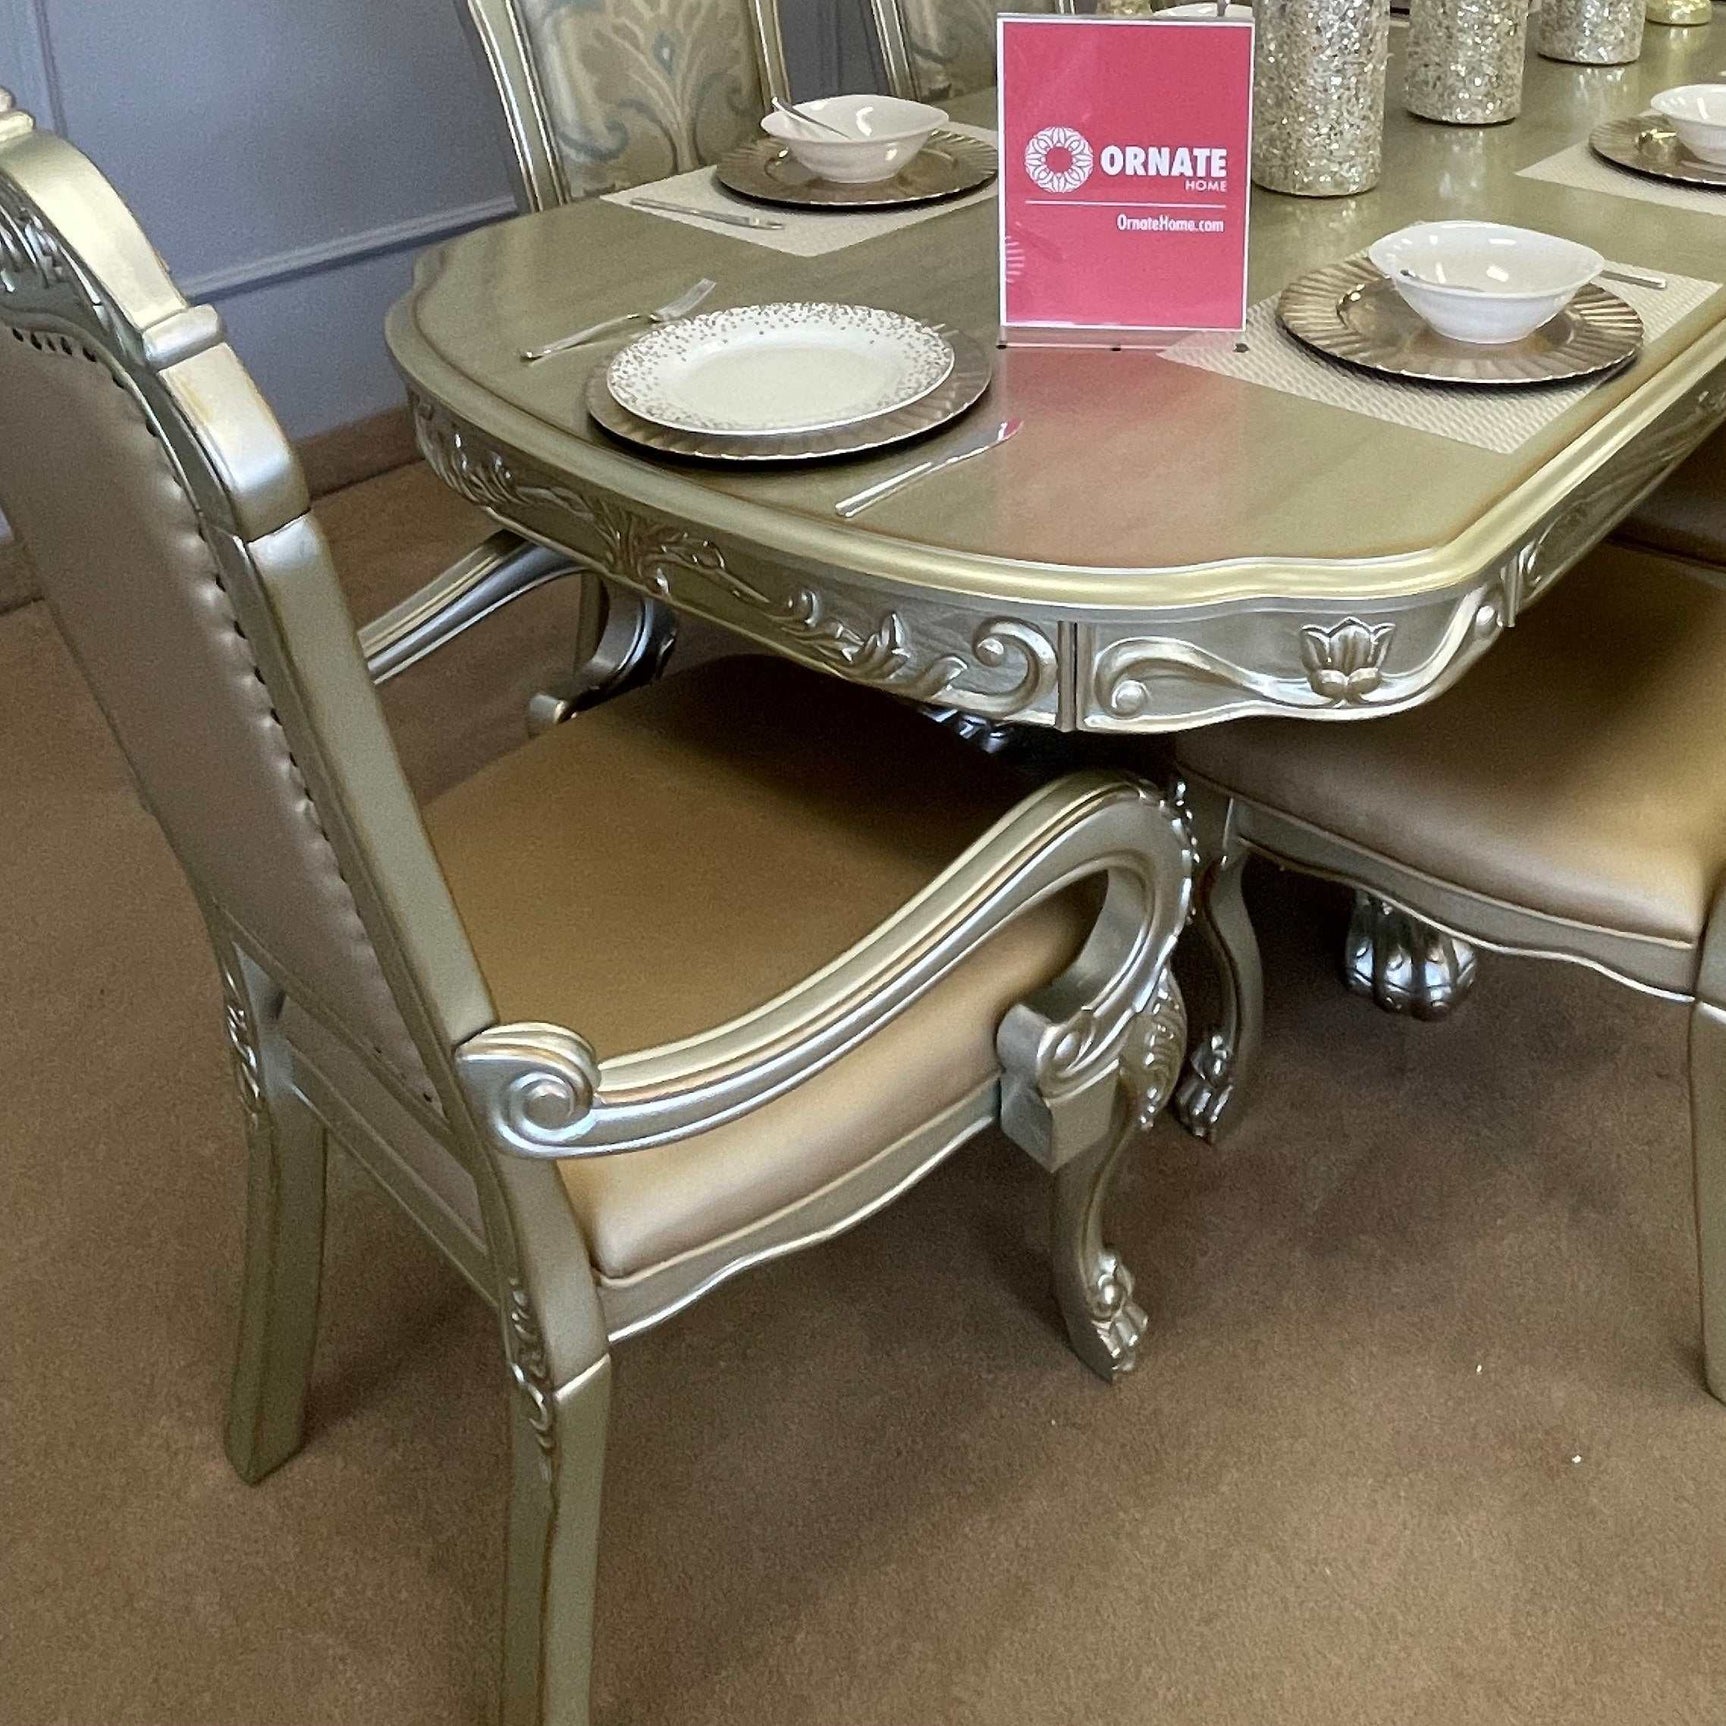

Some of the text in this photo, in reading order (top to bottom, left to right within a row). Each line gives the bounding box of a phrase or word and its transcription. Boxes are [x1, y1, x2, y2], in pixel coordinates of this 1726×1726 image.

[1100, 145, 1227, 177] ORNATE
[1185, 180, 1227, 192] HOME
[1117, 213, 1224, 232] OrnateHome.com
